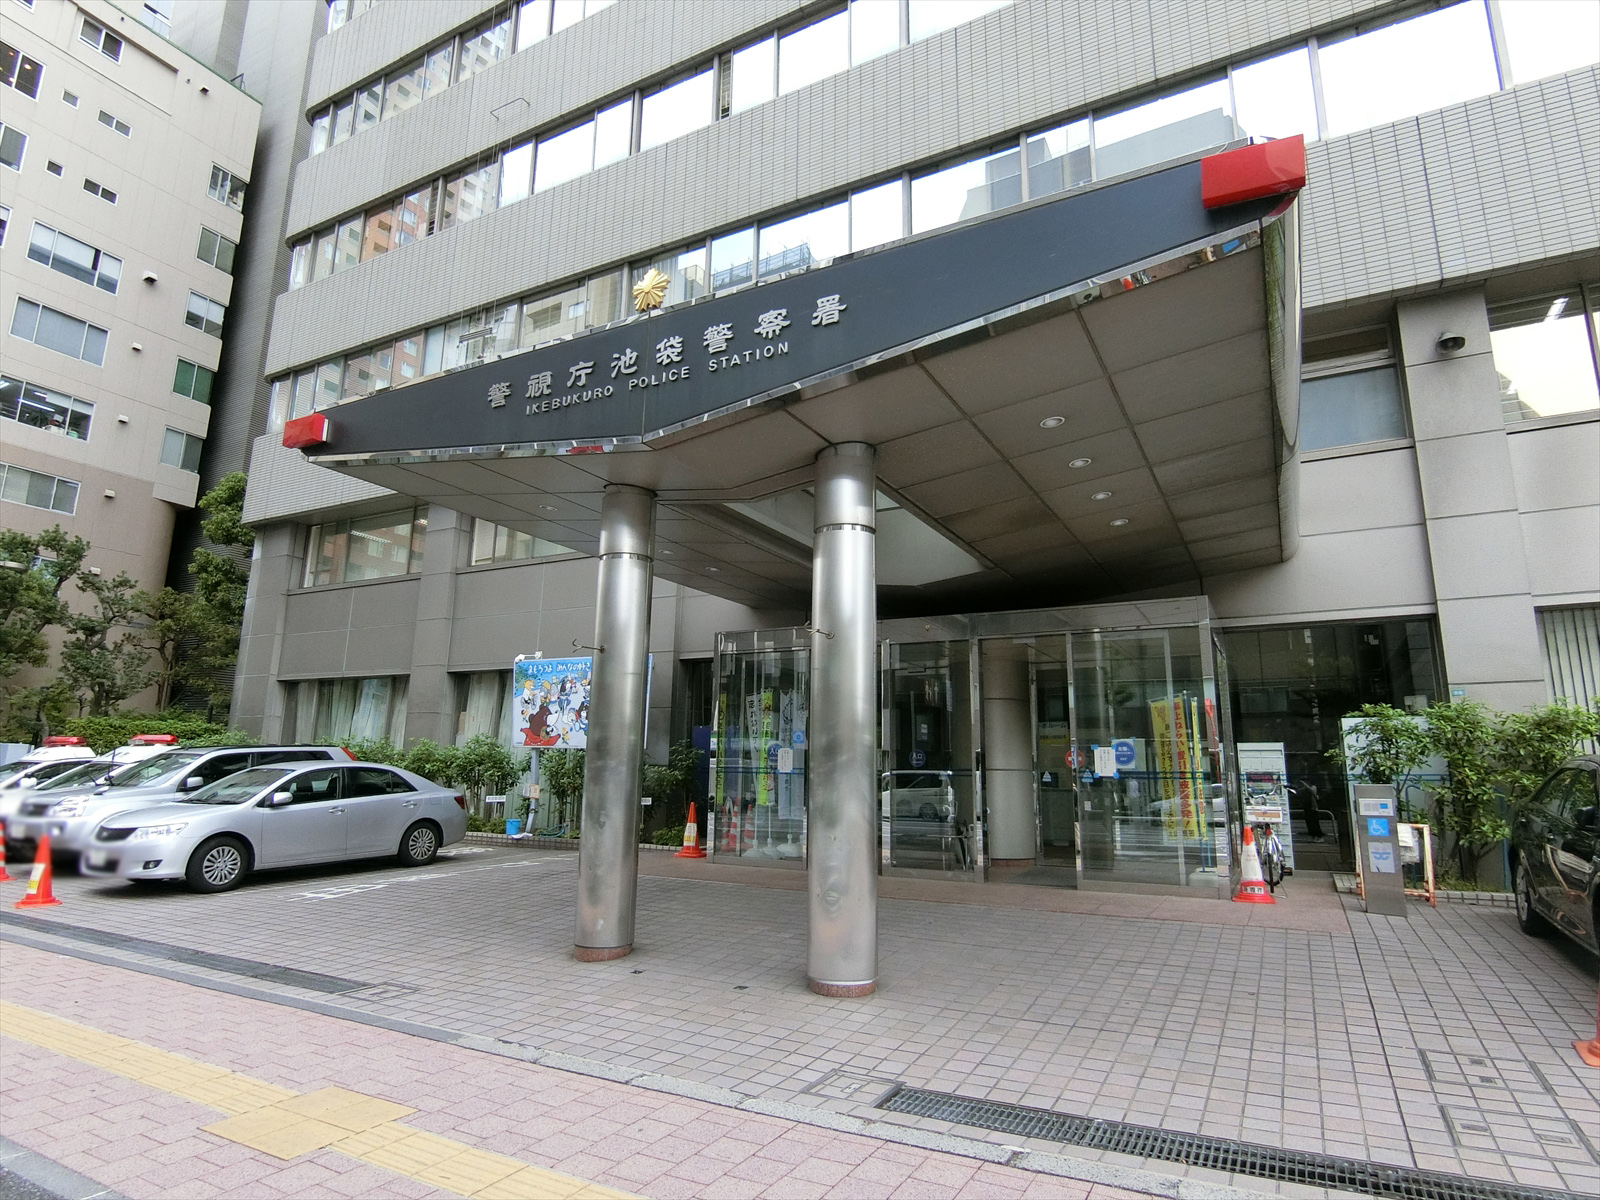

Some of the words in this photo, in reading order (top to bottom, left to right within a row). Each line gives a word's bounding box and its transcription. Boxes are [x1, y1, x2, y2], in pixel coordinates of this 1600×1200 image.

[487, 293, 848, 410] 警視庁池袋警察署
[525, 384, 615, 416] IKEBUKURO
[628, 365, 692, 392] POLICE
[707, 340, 790, 373] STATION
